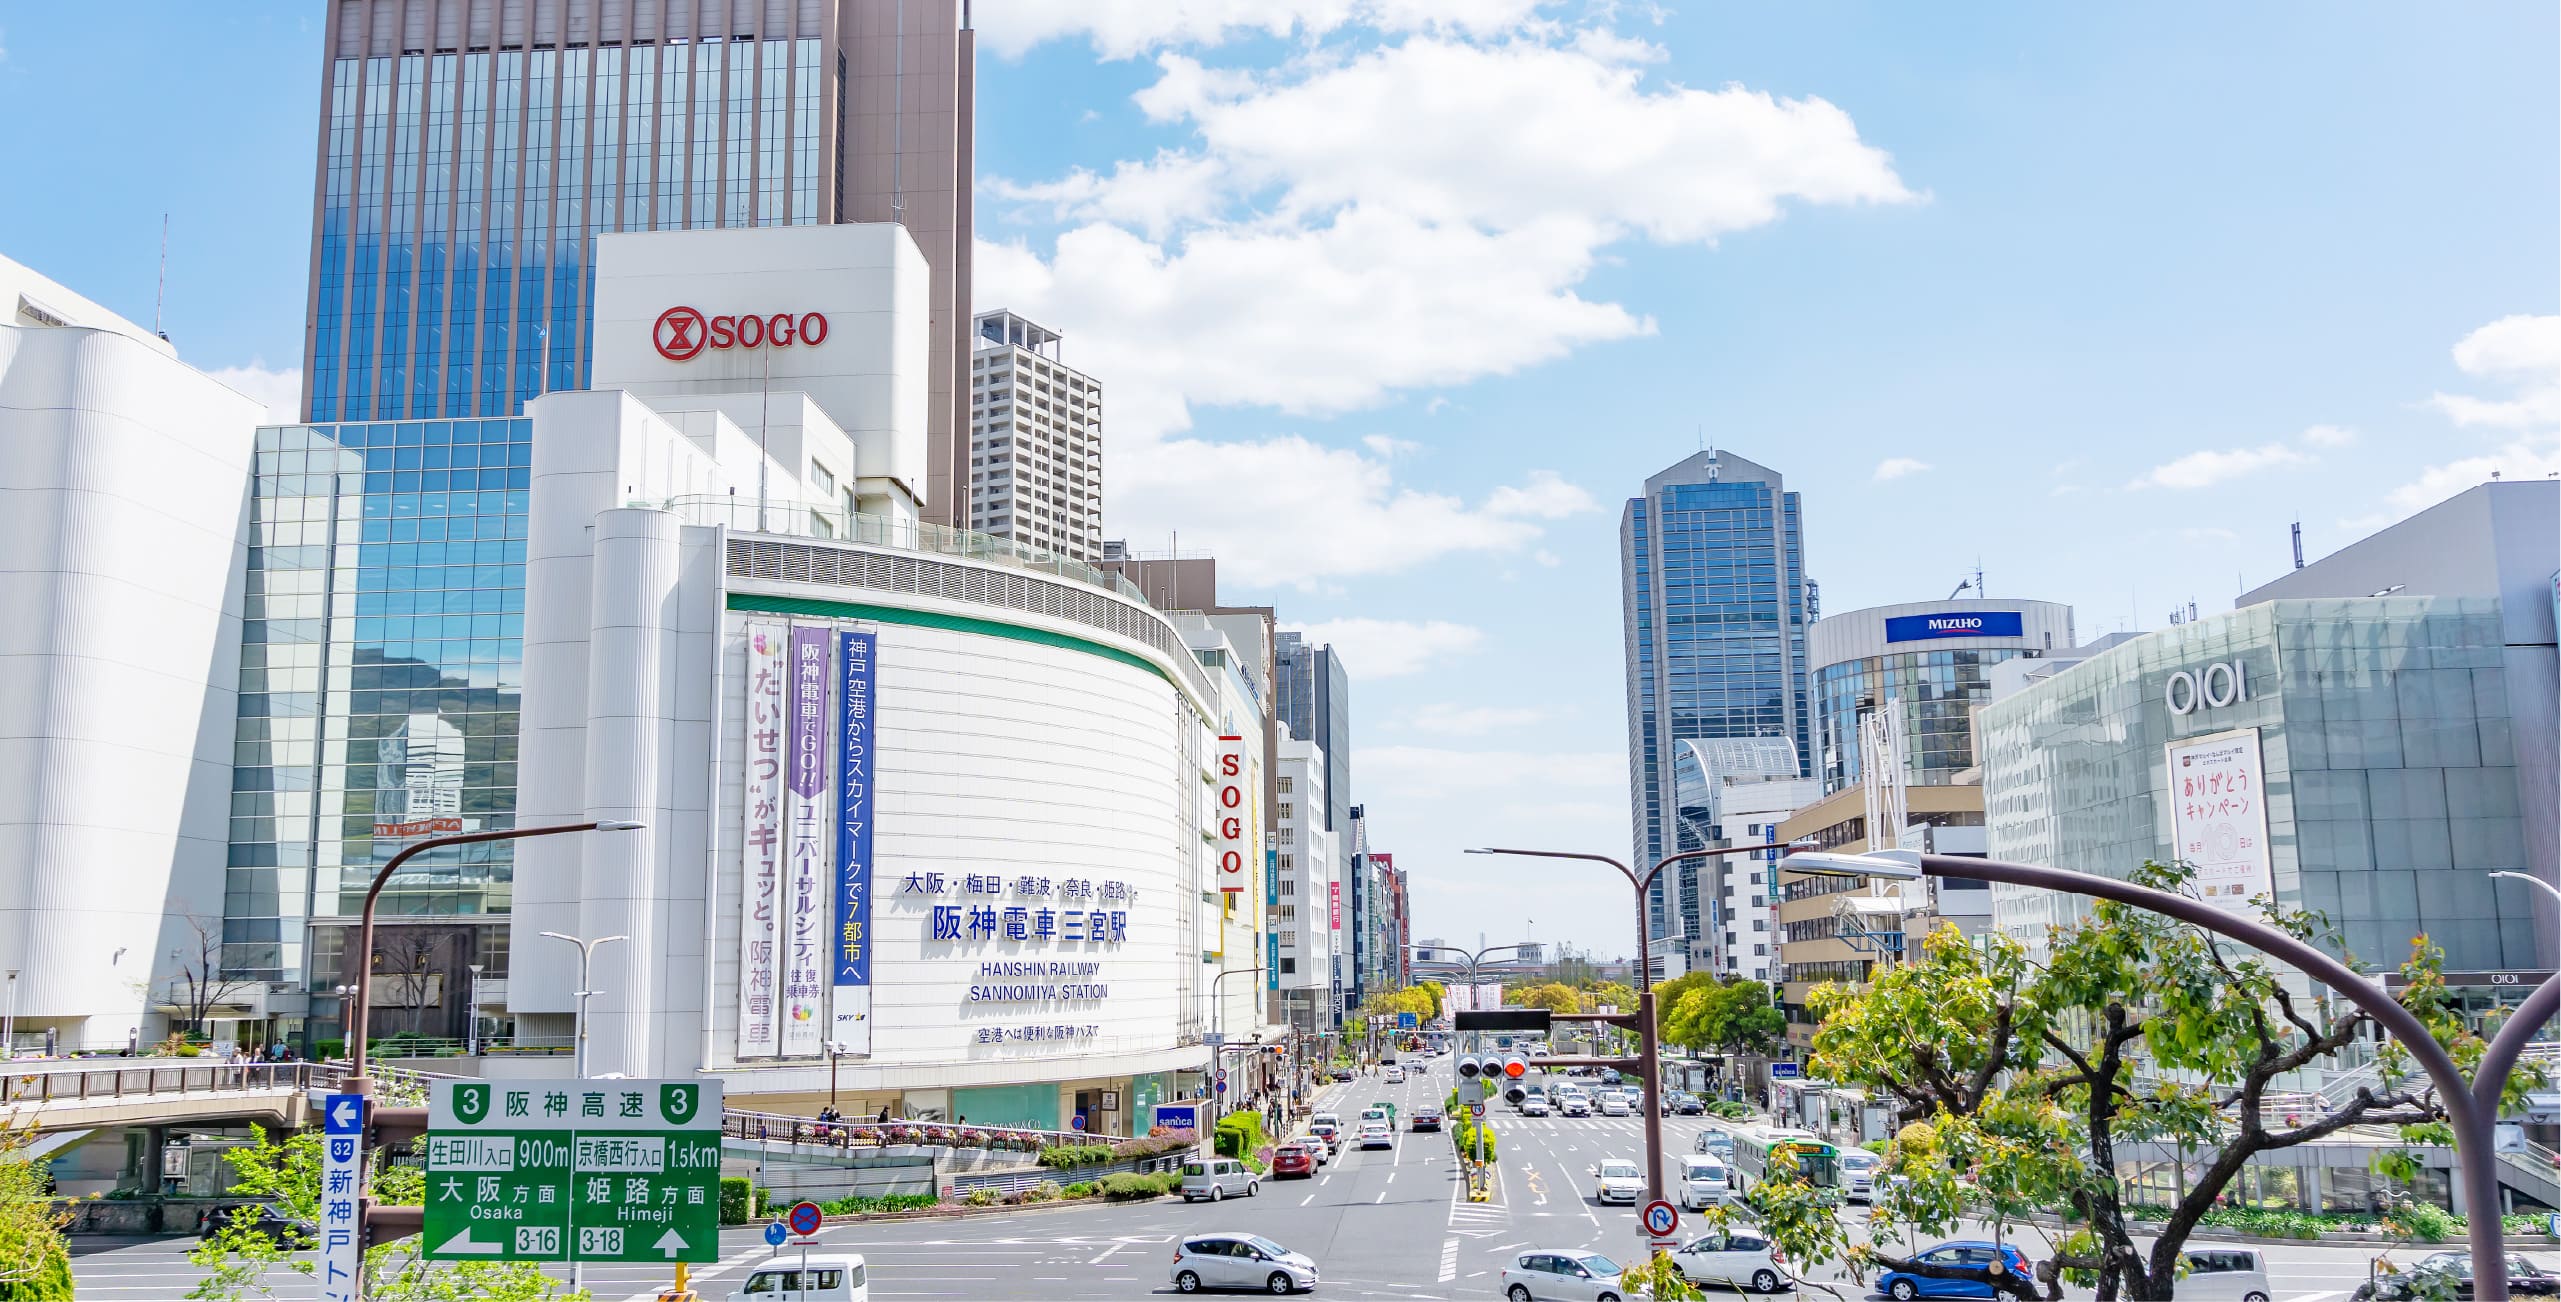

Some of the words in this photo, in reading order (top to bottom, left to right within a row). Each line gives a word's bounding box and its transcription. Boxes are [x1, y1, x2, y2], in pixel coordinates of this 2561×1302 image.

[710, 312, 828, 349] SOGO
[1928, 618, 1982, 630] MIZUHO
[2184, 768, 2248, 798] ありがとう
[843, 638, 867, 980] 神戸空港からスカイマークで7都市へ
[1221, 752, 1241, 874] SOGO
[2186, 798, 2250, 821] キャンペーン
[794, 804, 819, 966] ユニバーサルシティ
[932, 904, 1128, 942] 阪神電車三宮駅
[981, 962, 1046, 977] HANSHIN
[1050, 962, 1100, 977] RAILWAY
[970, 985, 1057, 1001] SANNOMIYA
[1062, 984, 1108, 1000] STATION
[462, 1088, 480, 1115] 3
[506, 1091, 643, 1118] 阪神高速
[670, 1088, 688, 1115] 3
[334, 1142, 351, 1156] 32
[431, 1139, 511, 1166] 生田川入口
[519, 1139, 569, 1168] 900m
[578, 1140, 661, 1167] 京橋西行入口
[668, 1140, 718, 1168] 1.5km
[470, 1205, 523, 1219] Osaka
[618, 1206, 673, 1223] Himeji
[518, 1229, 556, 1251] 3-16
[582, 1229, 620, 1252] 3-18
